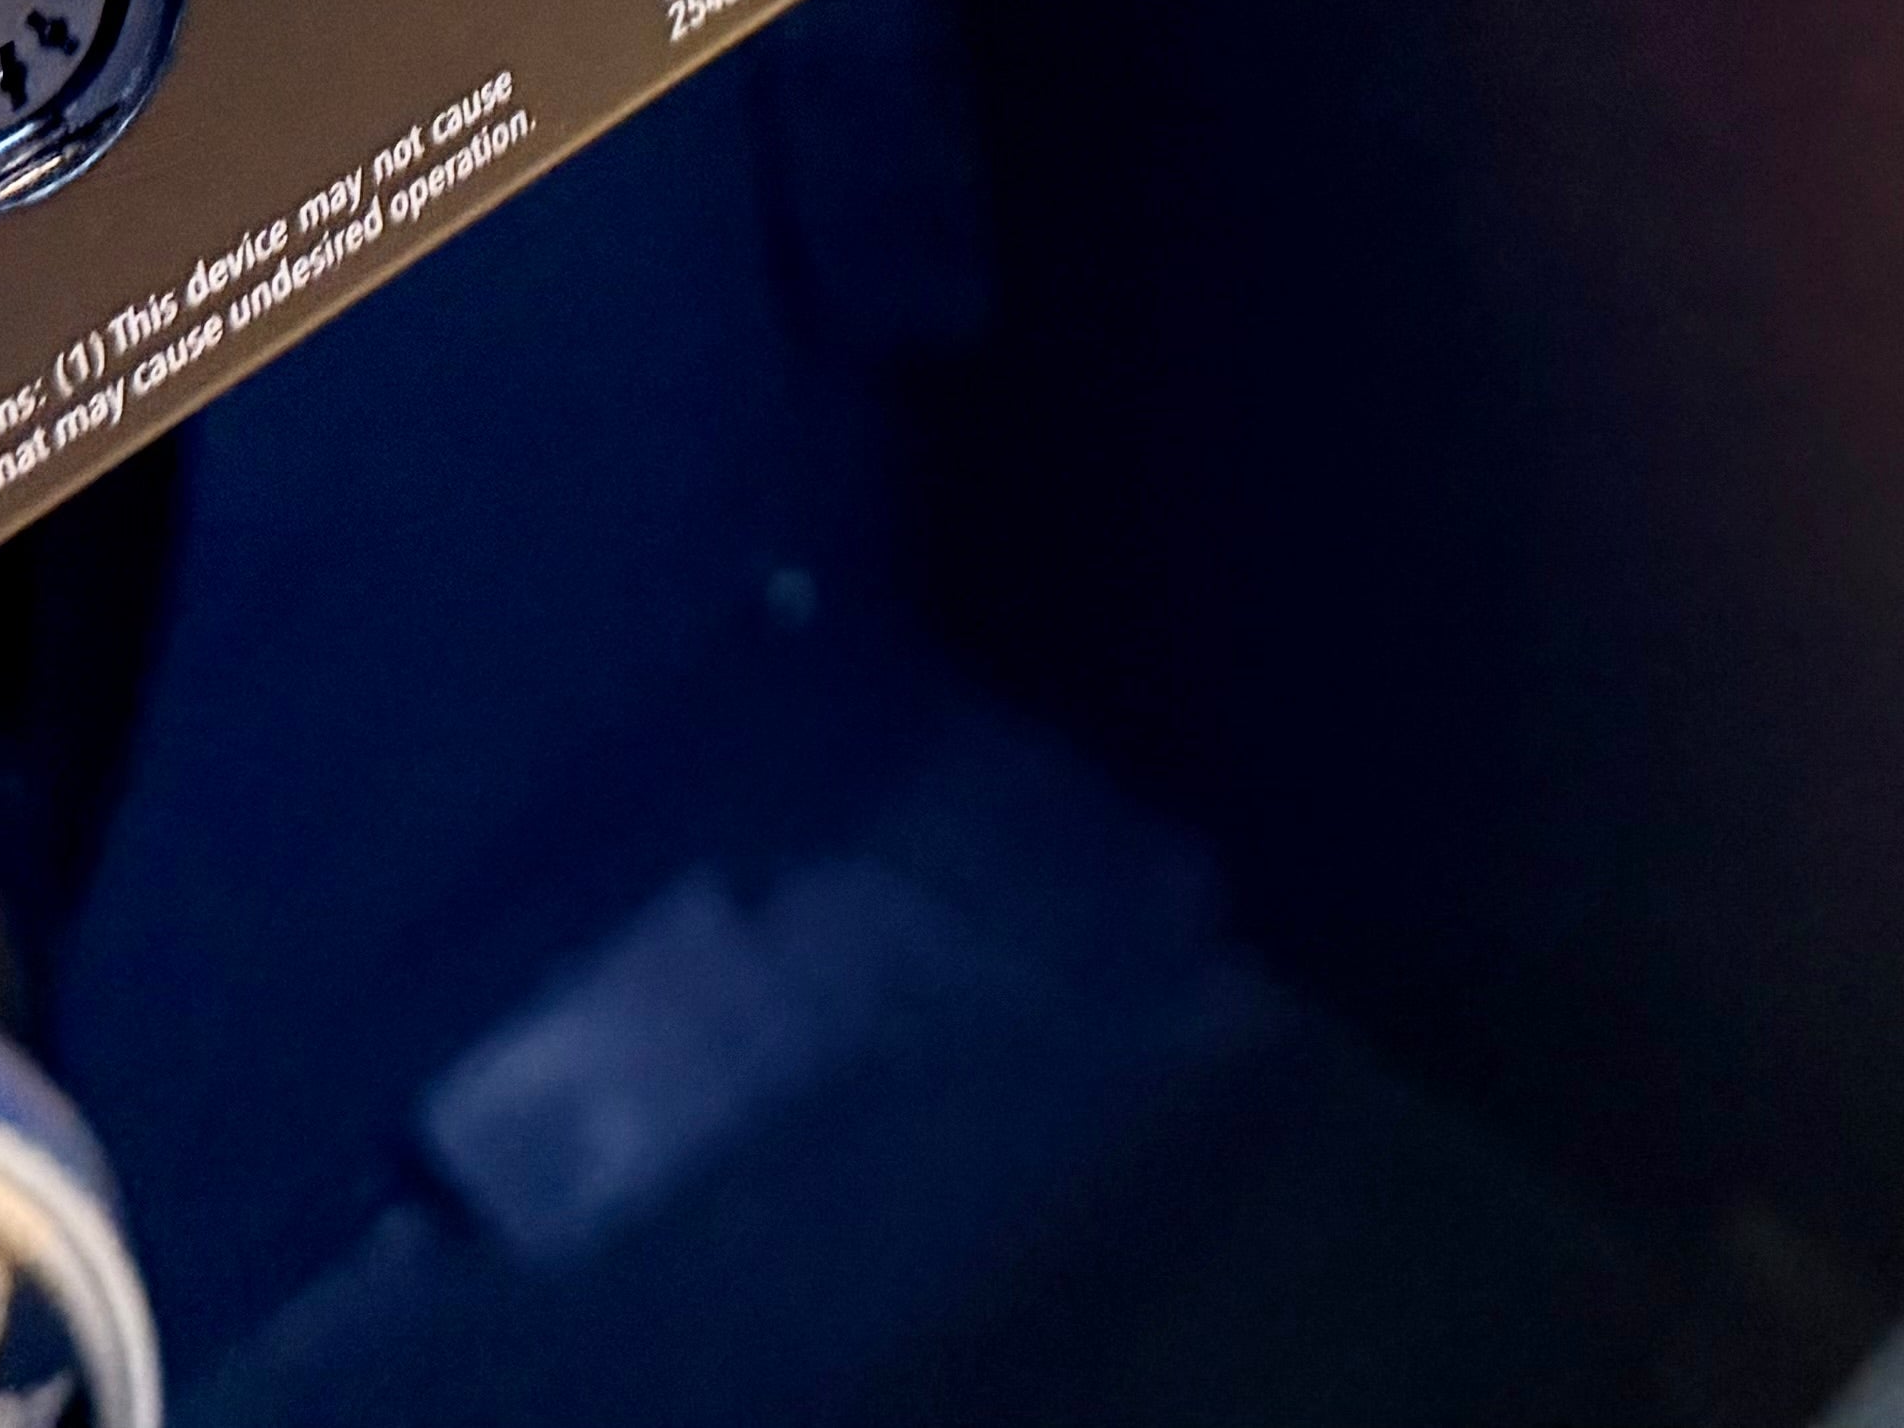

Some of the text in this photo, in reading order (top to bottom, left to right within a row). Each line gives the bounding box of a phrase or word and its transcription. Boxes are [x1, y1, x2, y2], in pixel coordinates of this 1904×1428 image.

[53, 331, 108, 401] (1)
[107, 287, 179, 354] This
[186, 219, 289, 307] device
[297, 165, 364, 231] may
[371, 124, 426, 187] not
[430, 67, 515, 144] cause
[53, 374, 127, 451] may
[130, 315, 225, 398] cause
[227, 204, 387, 333] undesired
[388, 108, 539, 228] operation.
